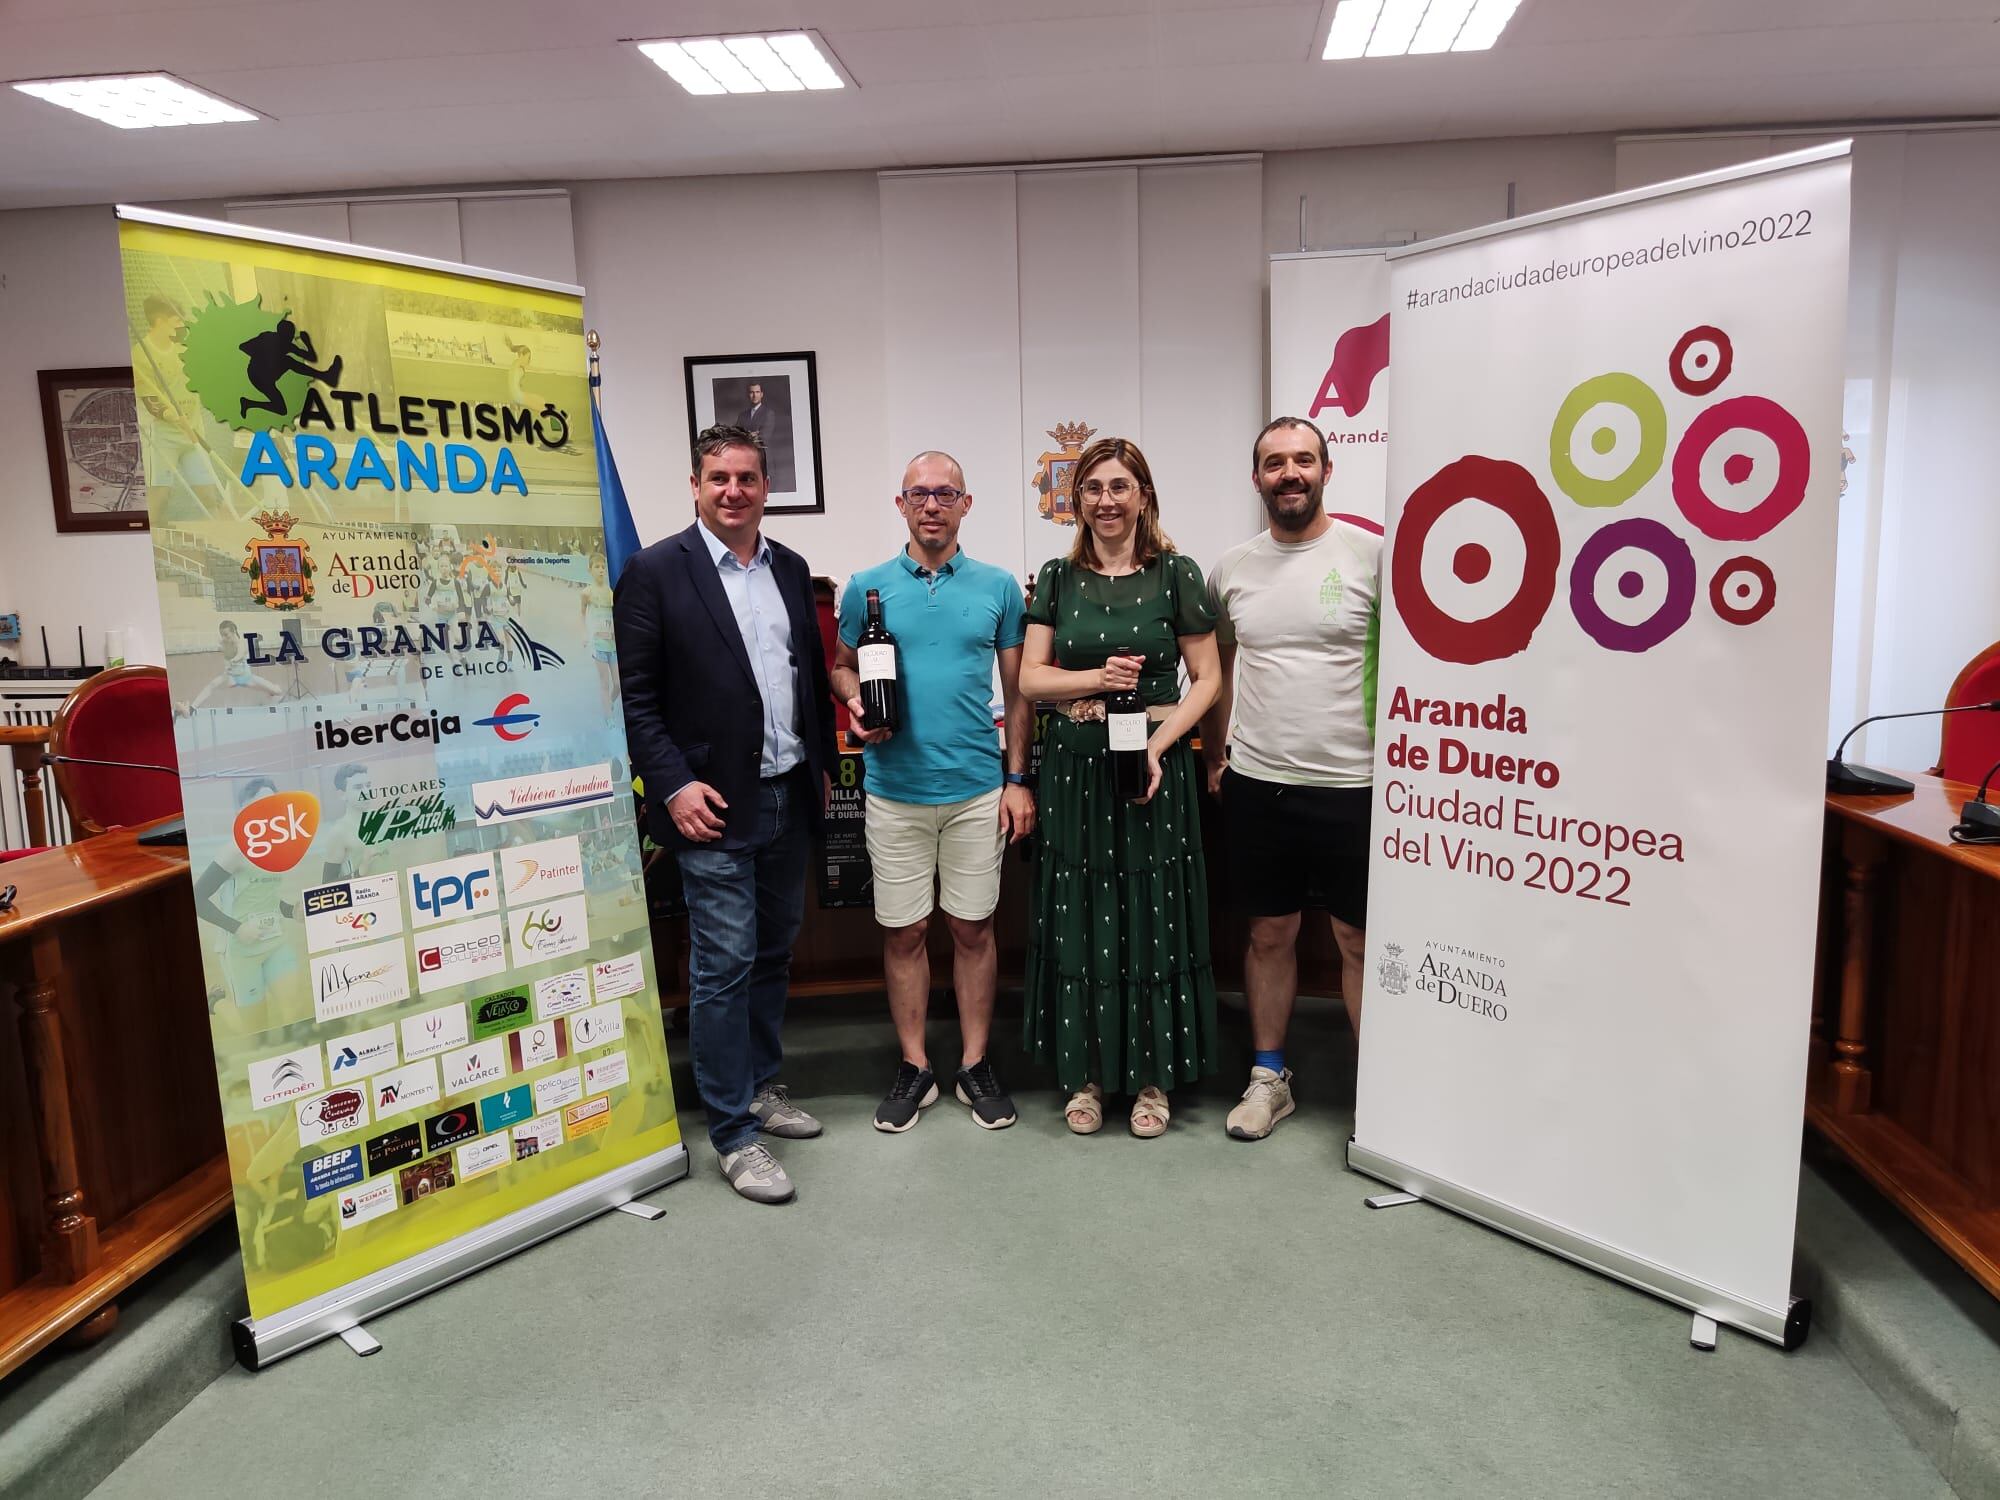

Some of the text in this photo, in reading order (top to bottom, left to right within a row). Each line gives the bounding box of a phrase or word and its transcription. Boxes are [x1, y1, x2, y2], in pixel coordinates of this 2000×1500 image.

[1406, 209, 1812, 310] #arandaciudadeuropeadelvino2022
[1327, 429, 1388, 444] Aranda
[240, 430, 528, 497] ARANDA
[322, 531, 419, 542] AYUNTAMIENTO
[328, 549, 420, 577] Aranda
[545, 557, 570, 565] Deportes
[332, 570, 421, 599] de Duero
[243, 619, 505, 666] LA GRANJA
[421, 660, 508, 680] DE CHICO
[1388, 686, 1527, 734] Aranda
[314, 709, 462, 751] iberCaja
[1387, 734, 1560, 789] de Duero
[357, 778, 447, 802] AUTOCARES
[509, 776, 609, 805] Vidriera Arandina
[825, 811, 865, 819] DE DUERO
[1385, 780, 1684, 862] Ciudad Europea
[243, 803, 312, 858] gsk
[540, 865, 579, 880] Patinter
[1383, 828, 1631, 906] del Vino 2022
[307, 891, 349, 912] SER
[356, 892, 379, 900] ARANDA
[1425, 940, 1505, 968] AYUNTAMIENTO
[1418, 953, 1508, 998] ARANDA
[486, 1000, 520, 1018] VELASCO
[1416, 975, 1507, 1022] de DUERO
[451, 1066, 500, 1088] VALCARCE
[263, 1082, 315, 1102] CITROËN
[401, 1088, 425, 1099] MONTES
[530, 1119, 559, 1133] PASTOR
[385, 1139, 420, 1156] Parrilla
[312, 1149, 352, 1174] BEEP
[359, 1189, 388, 1203] WEIMAR
